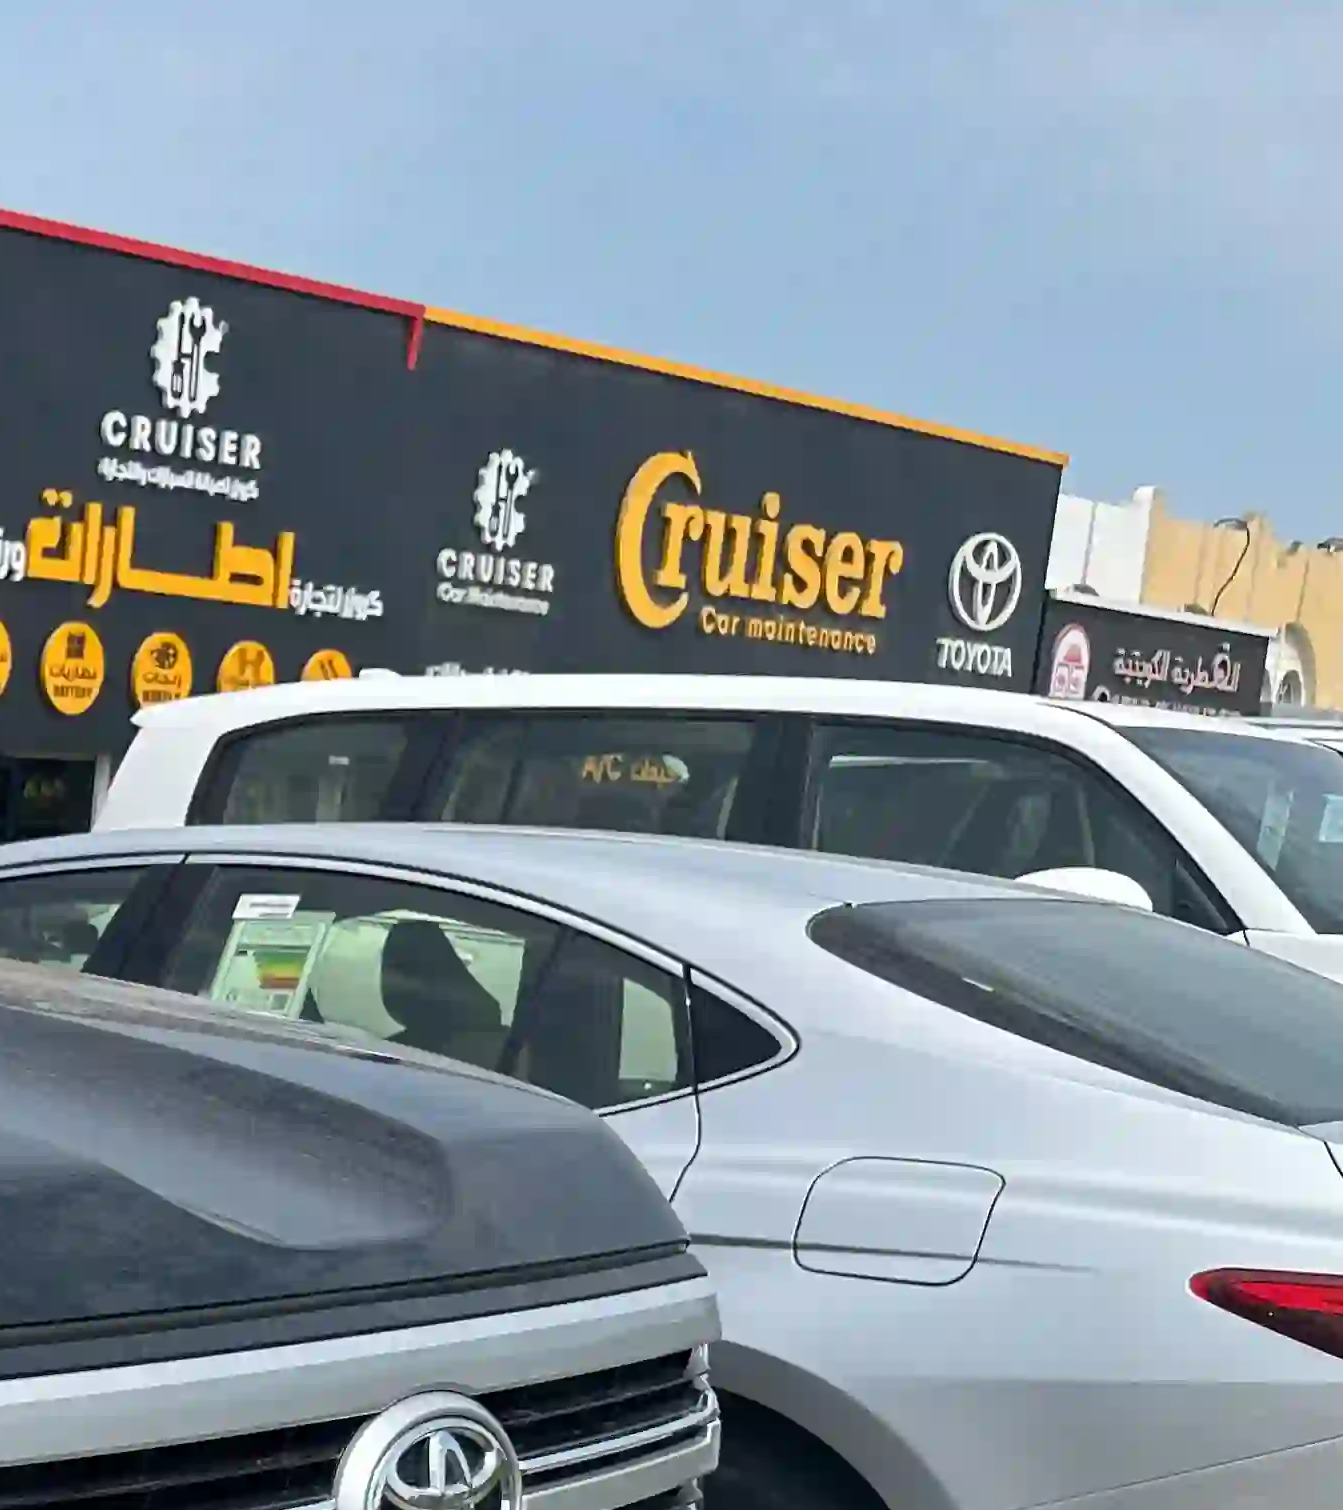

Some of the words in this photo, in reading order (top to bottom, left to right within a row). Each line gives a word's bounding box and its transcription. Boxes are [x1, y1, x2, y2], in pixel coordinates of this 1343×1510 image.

[99, 409, 263, 470] CRUISER
[615, 448, 904, 630] Cruiser
[437, 548, 555, 592] CRUISER
[701, 606, 740, 637] Car
[746, 616, 877, 656] maintenance
[935, 637, 1013, 677] TOYOTA
